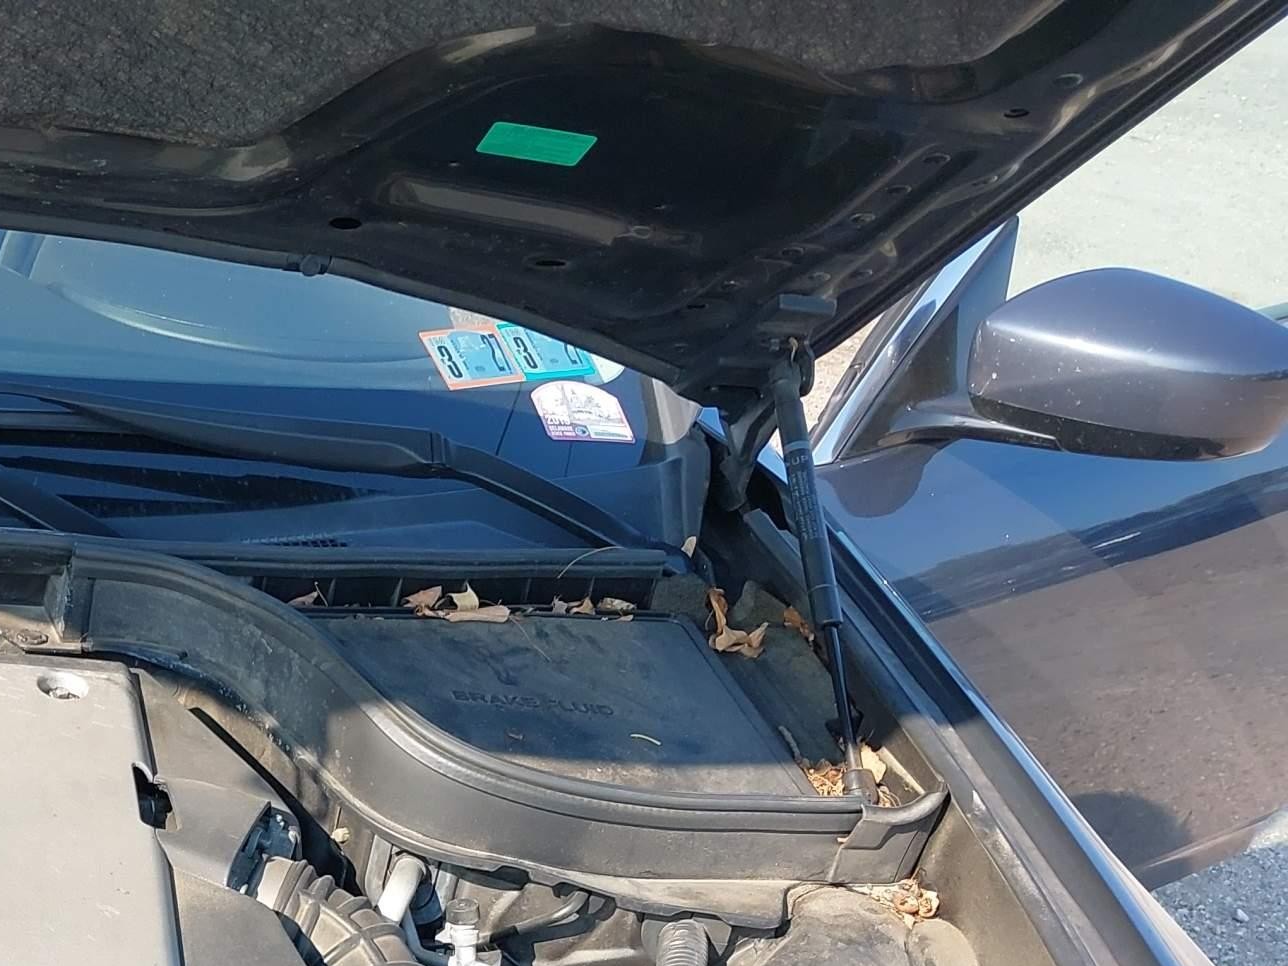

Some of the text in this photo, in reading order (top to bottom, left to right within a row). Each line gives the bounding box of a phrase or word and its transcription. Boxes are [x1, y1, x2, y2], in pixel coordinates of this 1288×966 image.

[437, 345, 463, 378] 3
[480, 333, 512, 371] 27
[513, 336, 538, 369] 3
[450, 690, 540, 709] BRAKE
